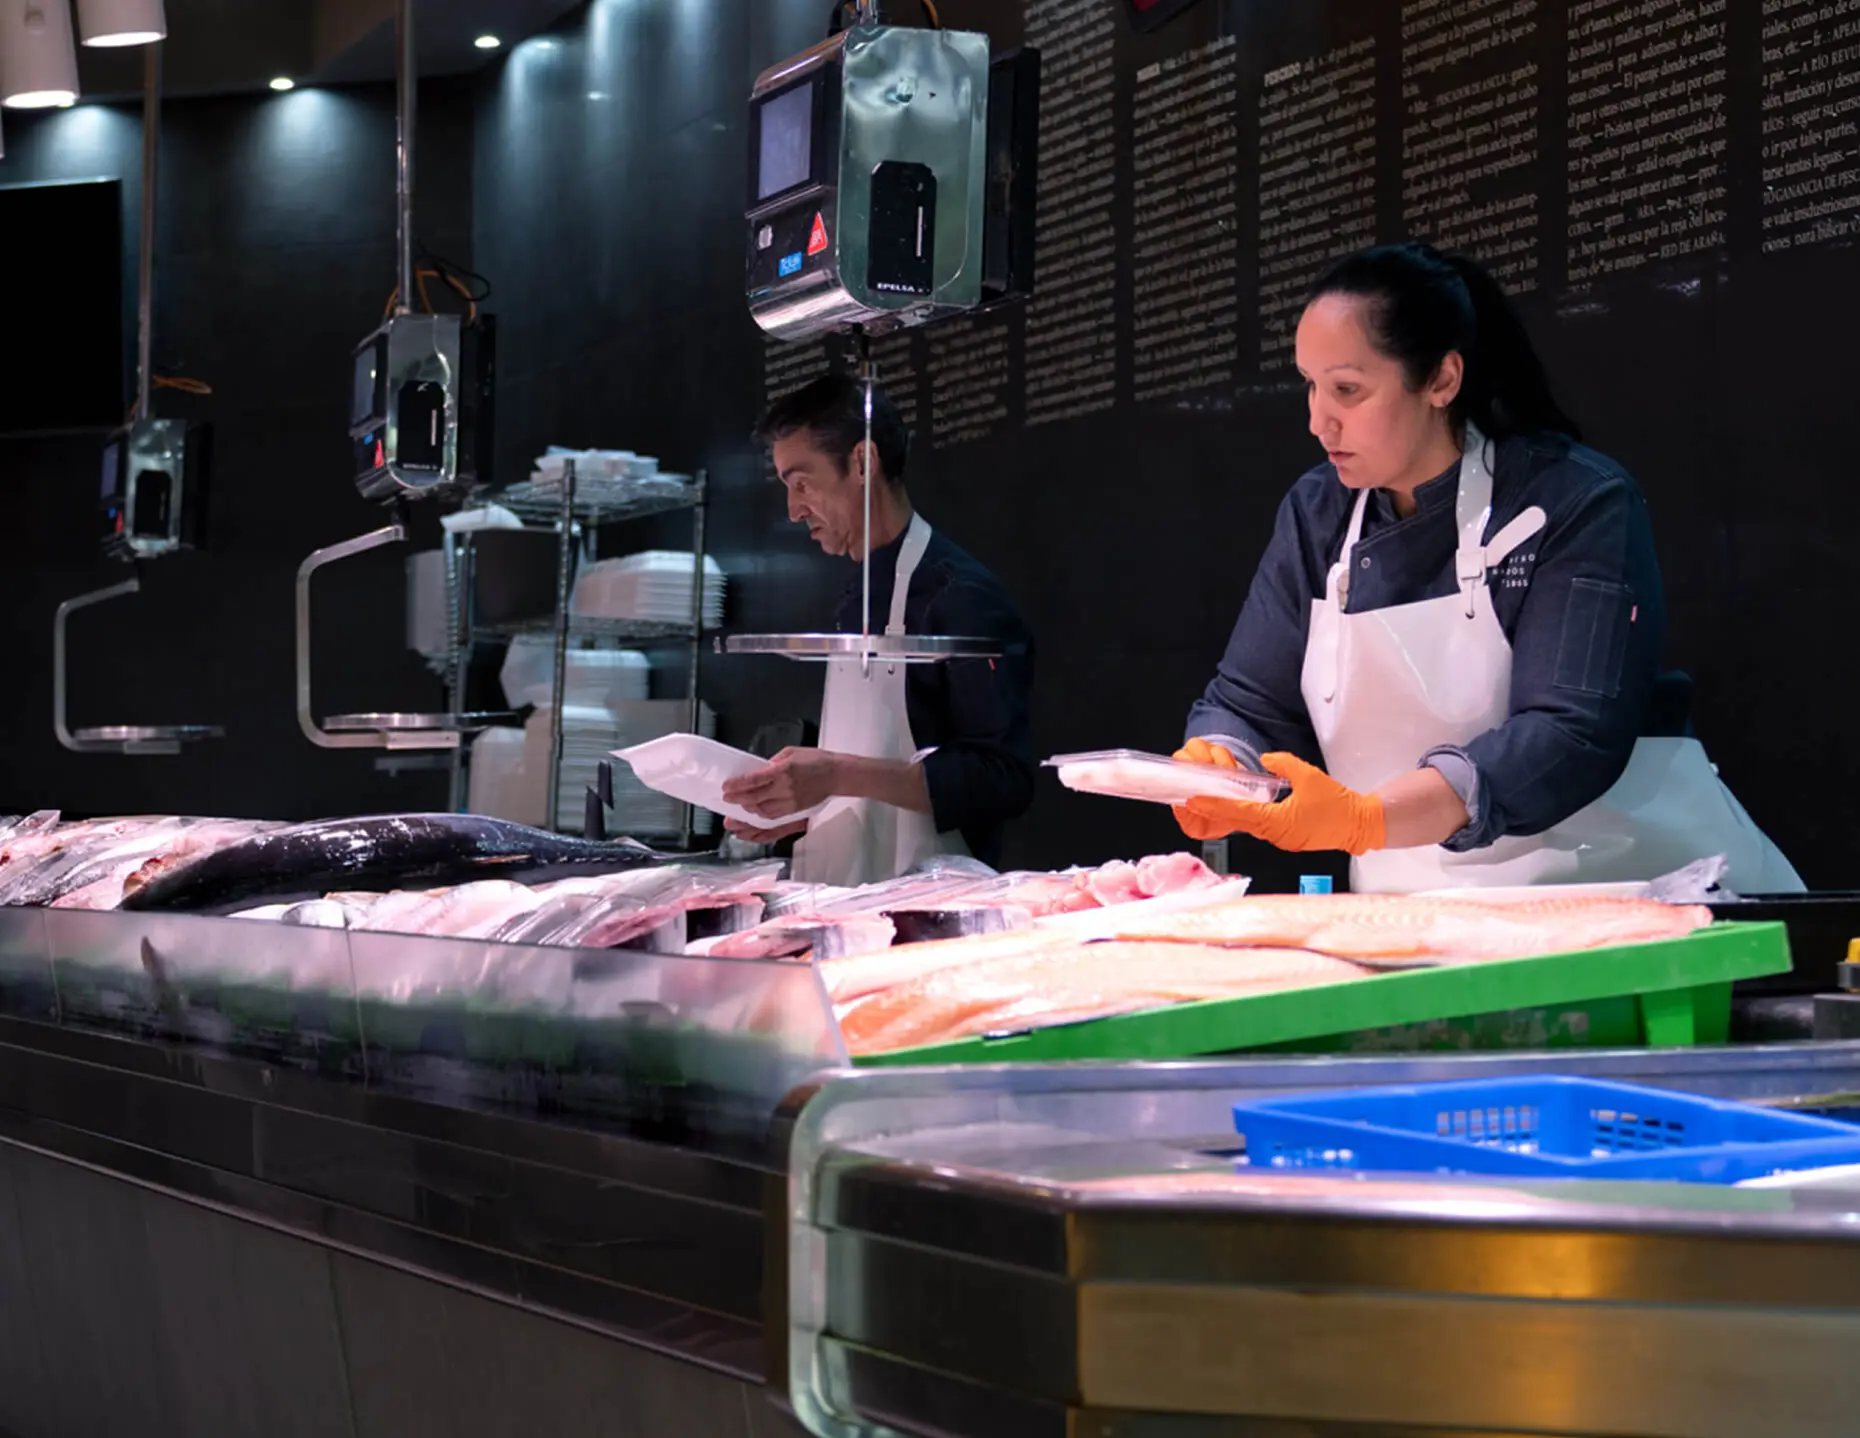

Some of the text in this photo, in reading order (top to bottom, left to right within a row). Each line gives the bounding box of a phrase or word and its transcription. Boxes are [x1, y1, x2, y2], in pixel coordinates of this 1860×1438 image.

[1832, 19, 1859, 41] APEA
[1831, 44, 1859, 66] REVU
[877, 282, 916, 293] EPELSA
